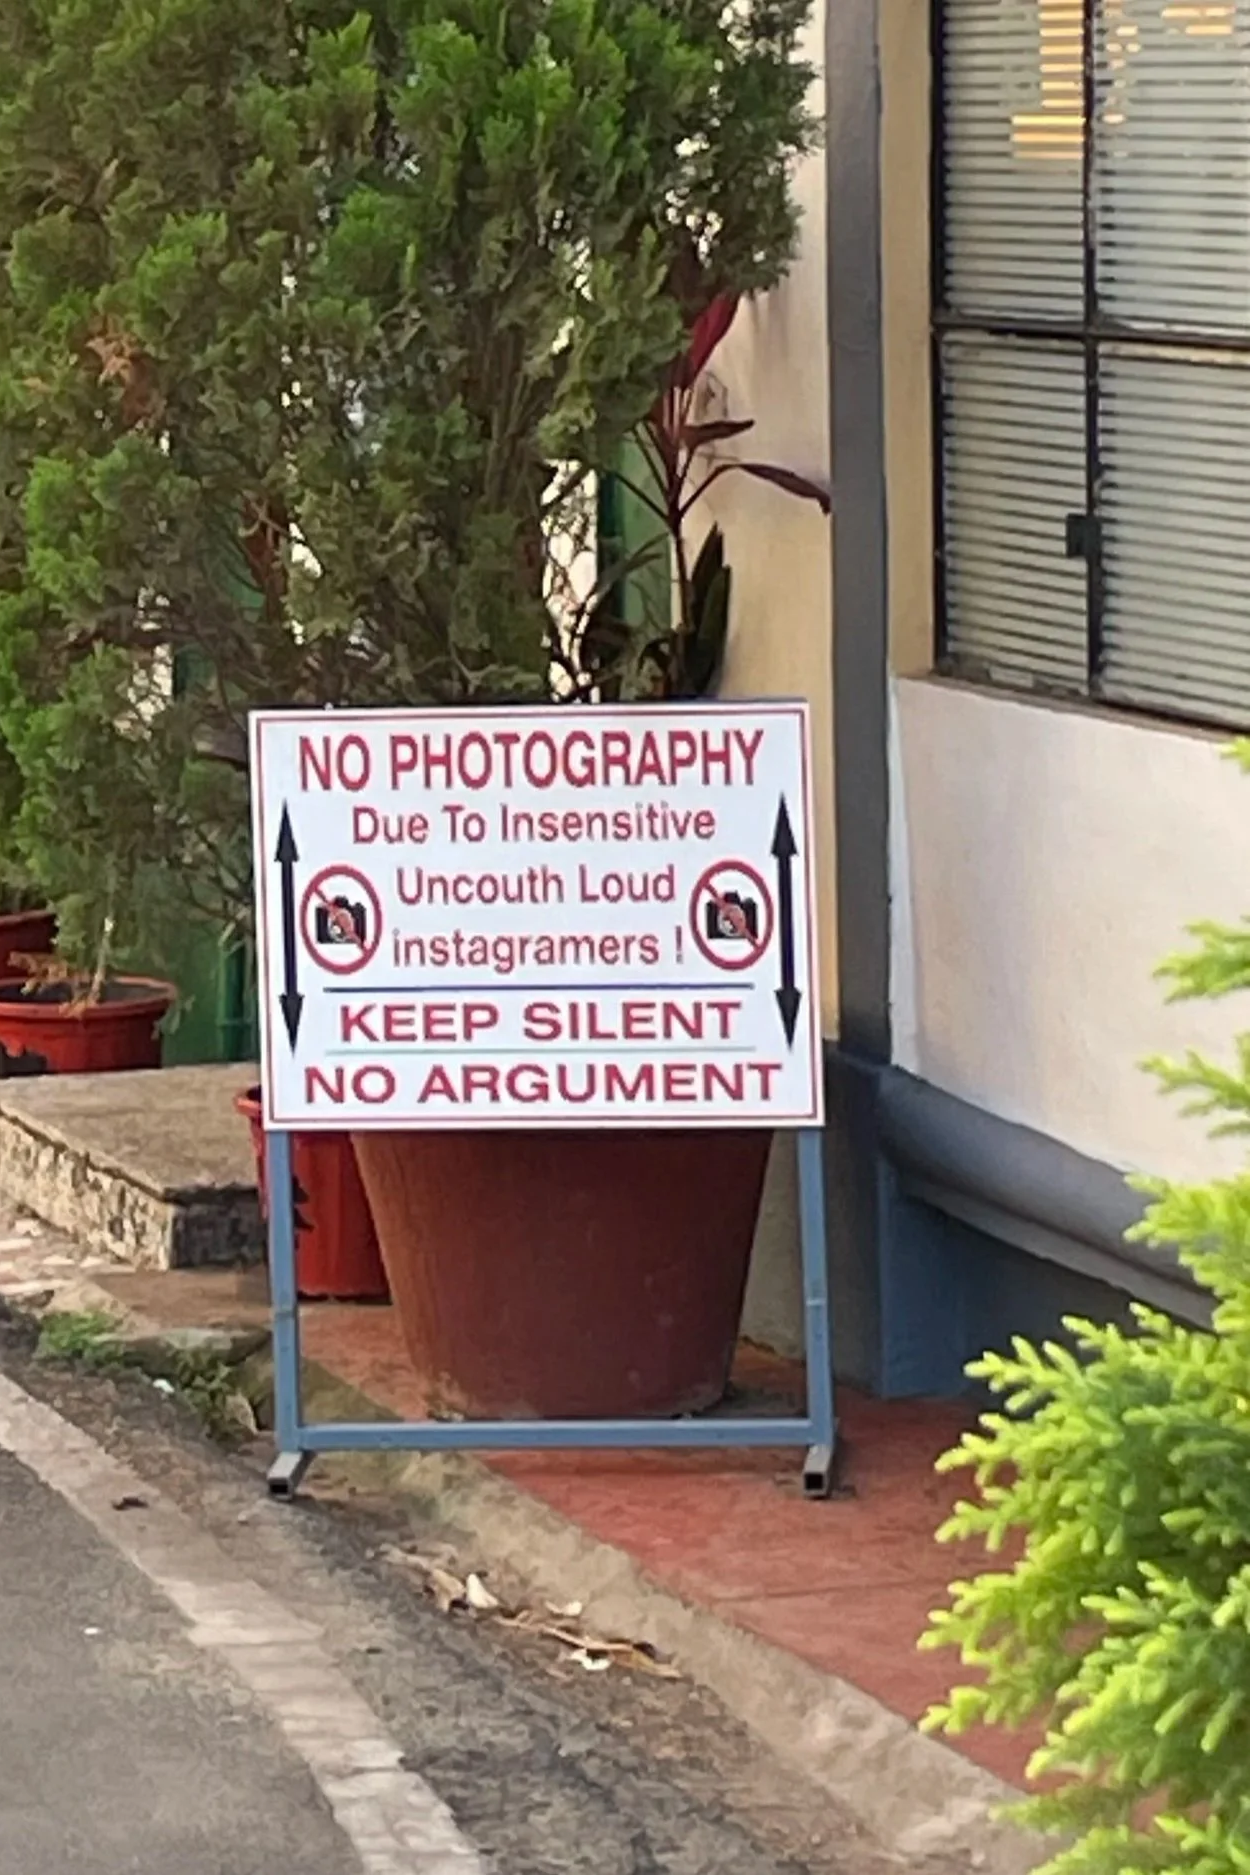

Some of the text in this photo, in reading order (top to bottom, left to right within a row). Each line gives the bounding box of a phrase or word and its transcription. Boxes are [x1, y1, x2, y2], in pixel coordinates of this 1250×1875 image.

[299, 728, 764, 791] NO PHOTOGRAPHY
[352, 801, 717, 844] Due To Insensitive
[396, 863, 676, 904] Uncouth Loud
[340, 1001, 742, 1043] KEEP SILENT
[305, 1063, 783, 1104] NO ARGUMENT
